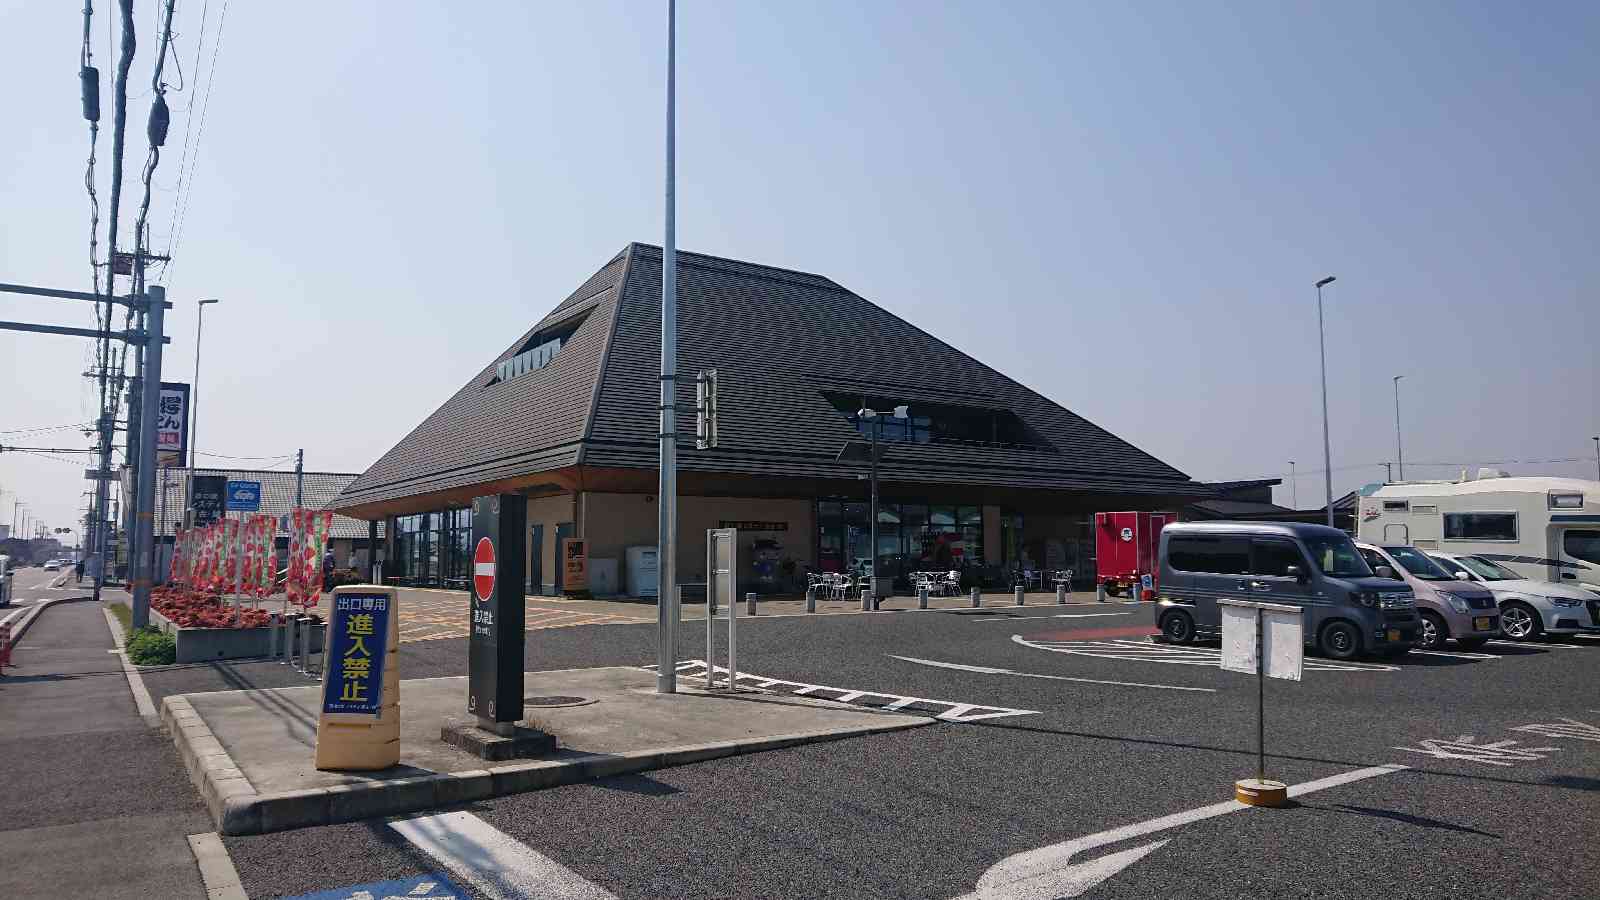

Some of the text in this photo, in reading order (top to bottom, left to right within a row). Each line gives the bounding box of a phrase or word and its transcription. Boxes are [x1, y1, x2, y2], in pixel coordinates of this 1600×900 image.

[337, 598, 386, 611] 出口専用
[339, 613, 374, 702] 進入禁止
